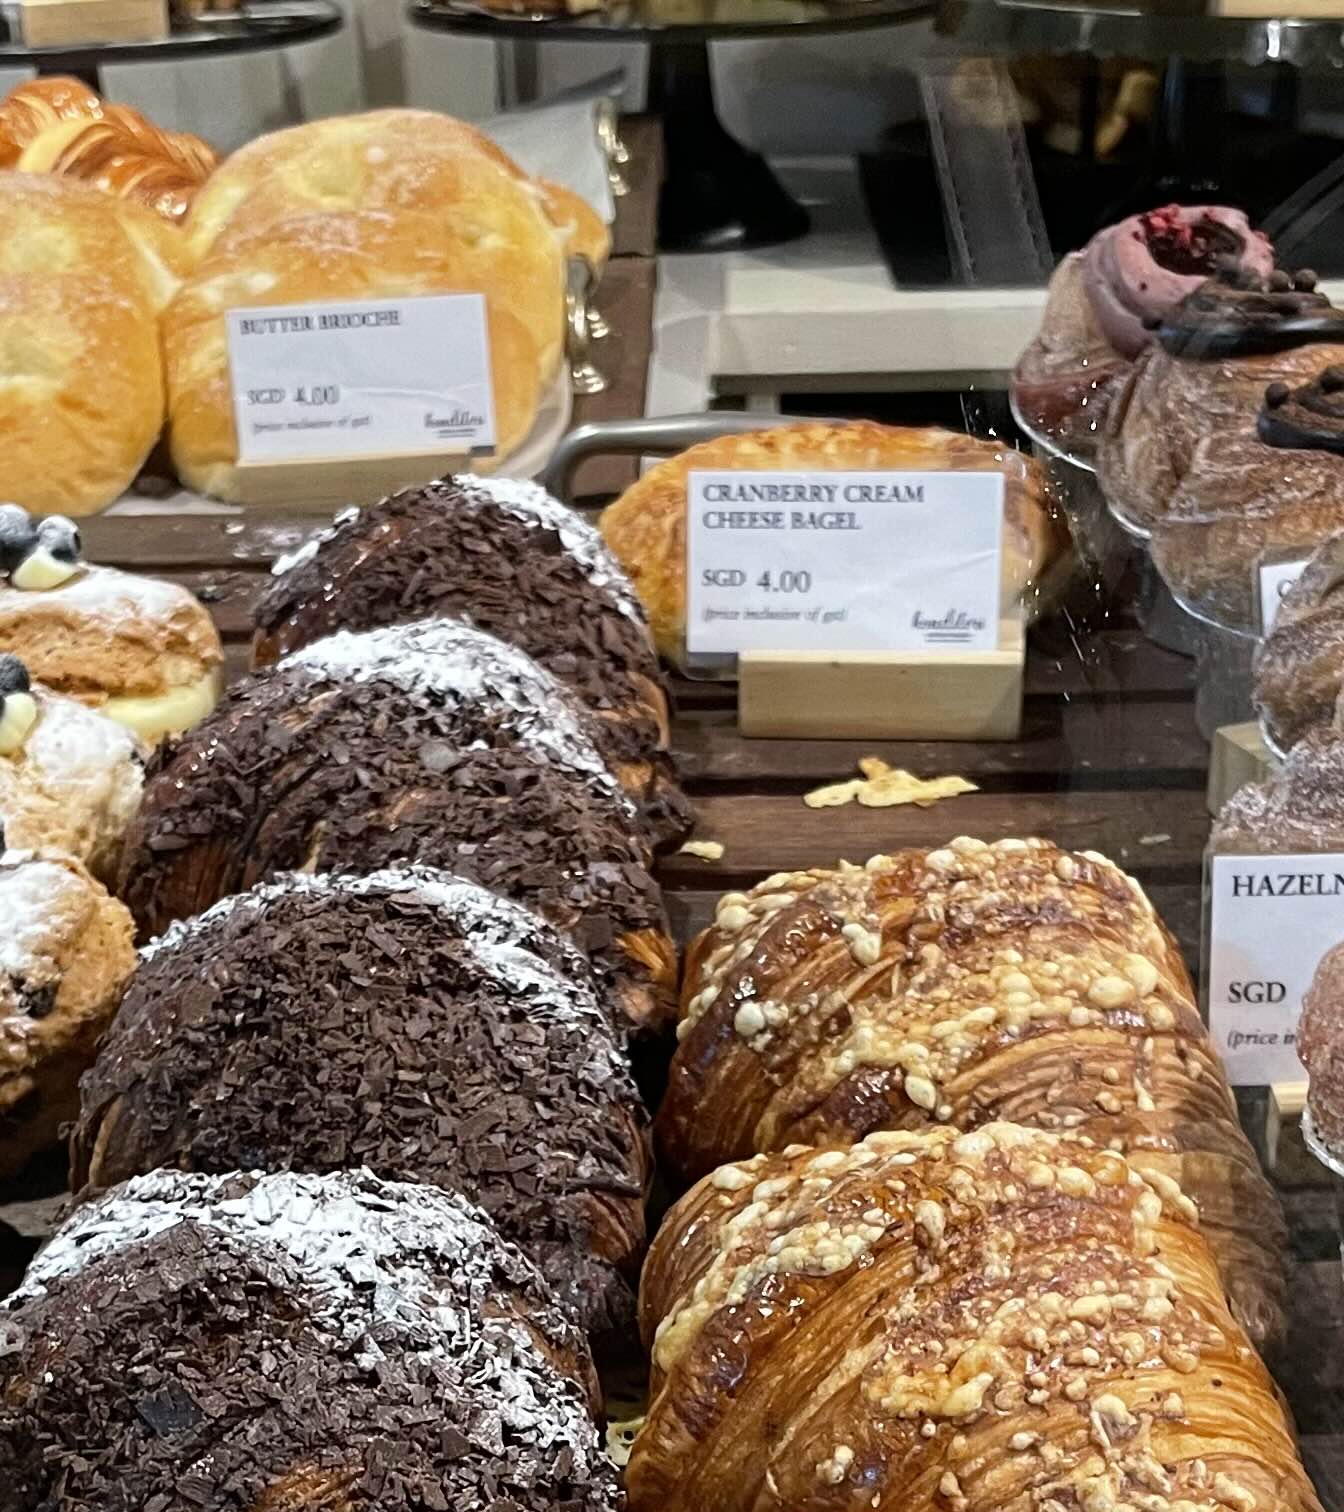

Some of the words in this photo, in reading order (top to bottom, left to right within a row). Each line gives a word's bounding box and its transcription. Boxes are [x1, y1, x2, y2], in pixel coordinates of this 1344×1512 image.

[240, 316, 313, 335] BUTTER
[318, 310, 401, 329] BRIOCHE
[292, 386, 340, 405] 4.00
[702, 484, 838, 502] CRANBERRY
[843, 485, 925, 503] CREAM
[702, 511, 785, 530] CHEESE
[791, 512, 860, 530] BAGEL
[702, 569, 746, 587] SGD
[756, 570, 811, 592] 4.00
[1228, 981, 1287, 1003] SGD
[1227, 1029, 1280, 1047] (price
